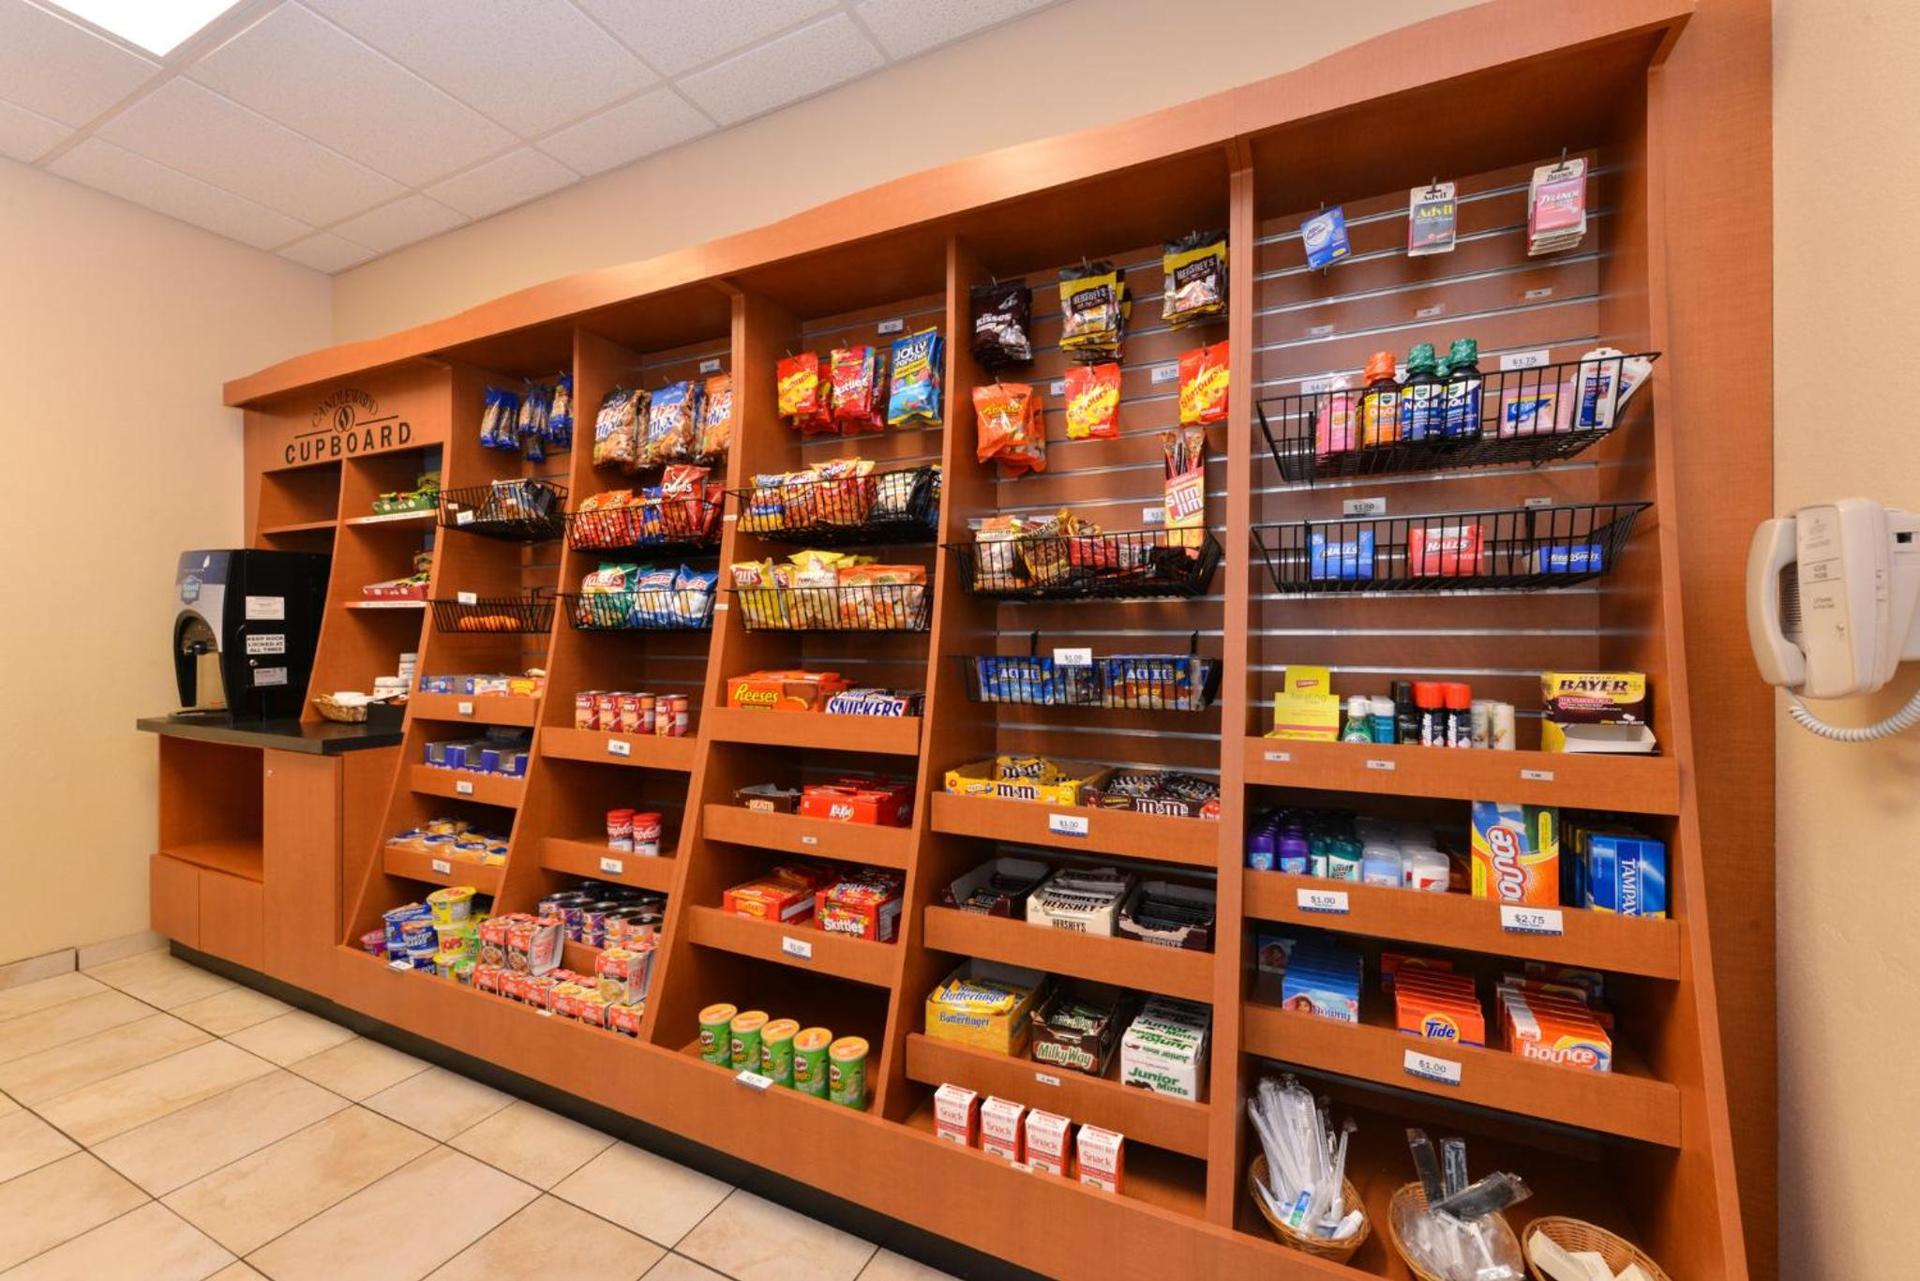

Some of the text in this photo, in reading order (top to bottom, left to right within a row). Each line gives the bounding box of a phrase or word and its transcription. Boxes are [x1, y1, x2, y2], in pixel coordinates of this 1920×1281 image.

[1417, 205, 1453, 220] Advil
[896, 340, 927, 361] JOLLY
[285, 422, 411, 464] CUPBOARD
[1426, 541, 1470, 553] HALLS
[1558, 679, 1629, 692] BAYER
[829, 700, 904, 717] SNICKERS
[1489, 828, 1524, 900] ounce
[1621, 857, 1637, 917] TAMPAX
[1310, 896, 1336, 907] $1.00
[824, 918, 864, 934] Skittles
[1052, 918, 1087, 933] HERSHEY'S
[1514, 914, 1545, 925] $2.75
[938, 1012, 990, 1030] Butterfinger
[1424, 1019, 1456, 1039] Tide
[1523, 1040, 1599, 1065] bounce
[1418, 1059, 1446, 1074] $1.00
[1128, 1066, 1180, 1085] Junior
[1156, 1082, 1189, 1096] Mints
[1083, 1151, 1112, 1168] Snack
